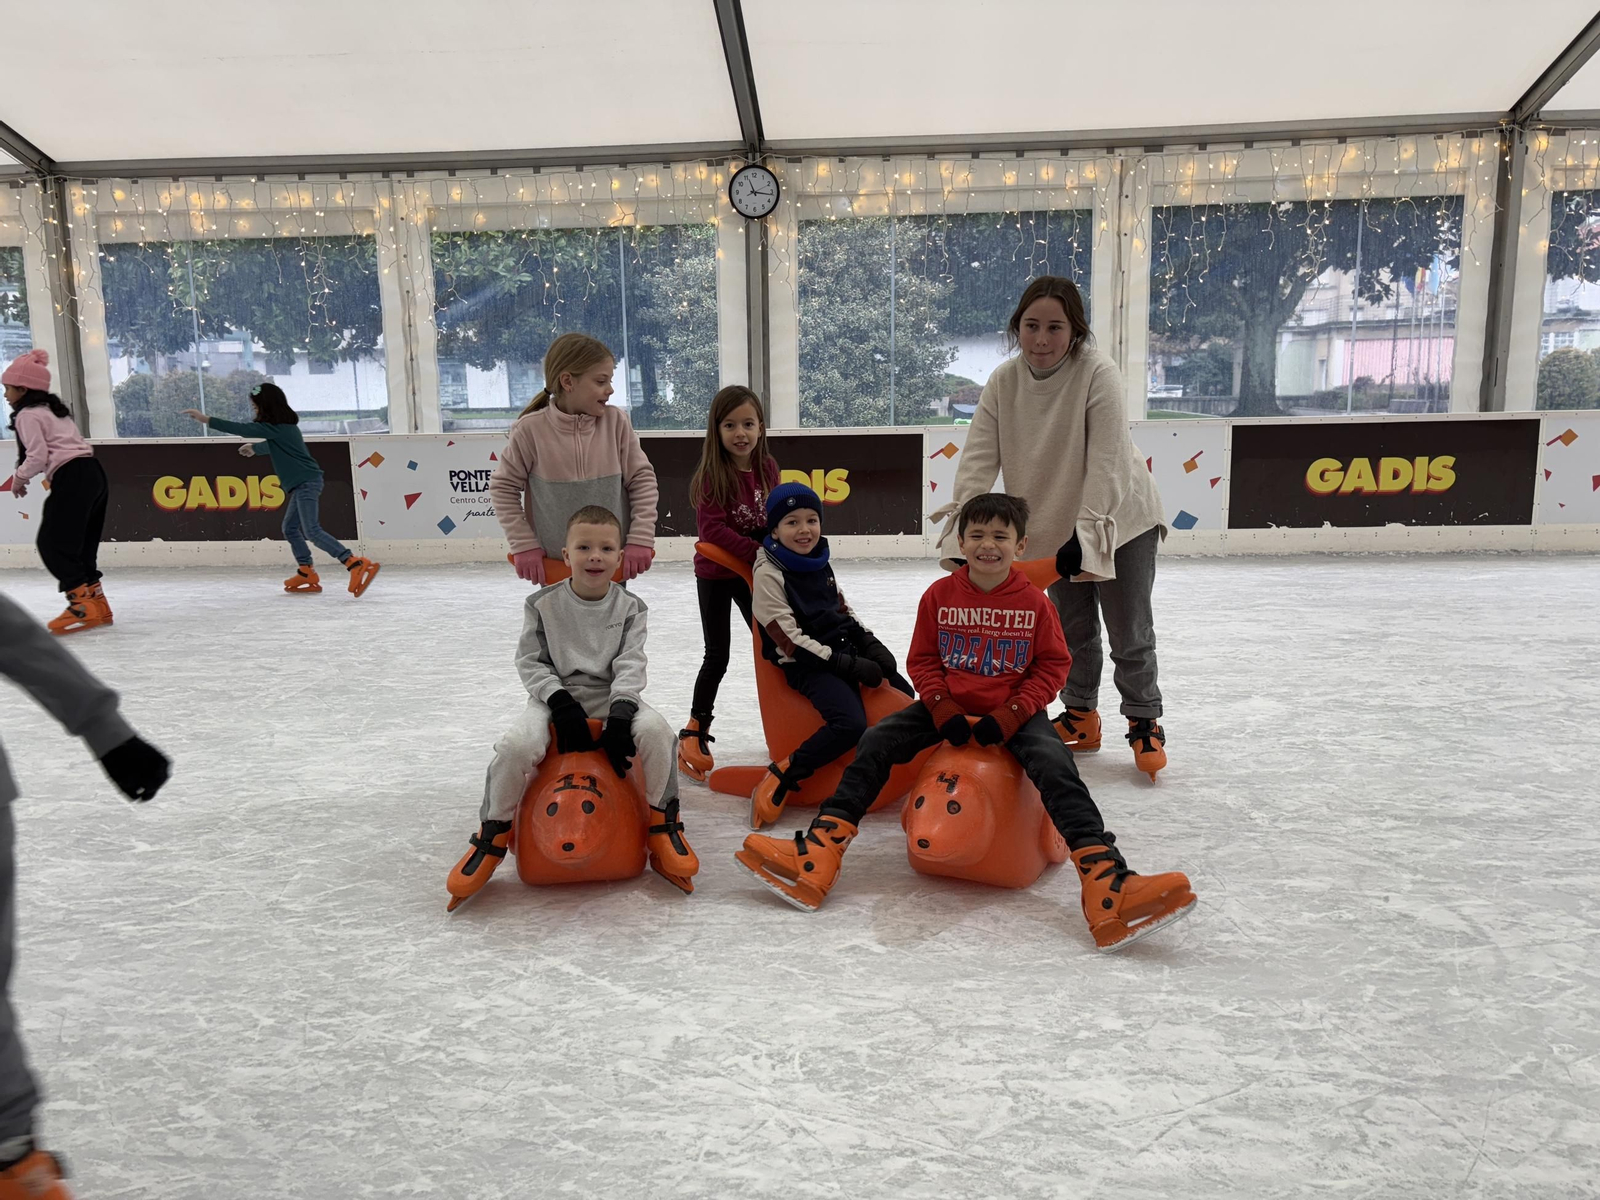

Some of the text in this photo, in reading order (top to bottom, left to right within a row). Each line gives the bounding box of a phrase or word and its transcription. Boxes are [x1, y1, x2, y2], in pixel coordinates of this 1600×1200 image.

[1304, 455, 1457, 497] GADIS
[152, 474, 286, 512] GADIS
[450, 496, 476, 504] Centro
[937, 607, 1036, 629] CONNECTED
[982, 628, 1000, 637] Energy
[1001, 629, 1024, 637] doesn't
[1025, 630, 1033, 638] lie
[937, 631, 1030, 677] BREATH
[553, 773, 604, 799] 11
[935, 771, 960, 794] 4
